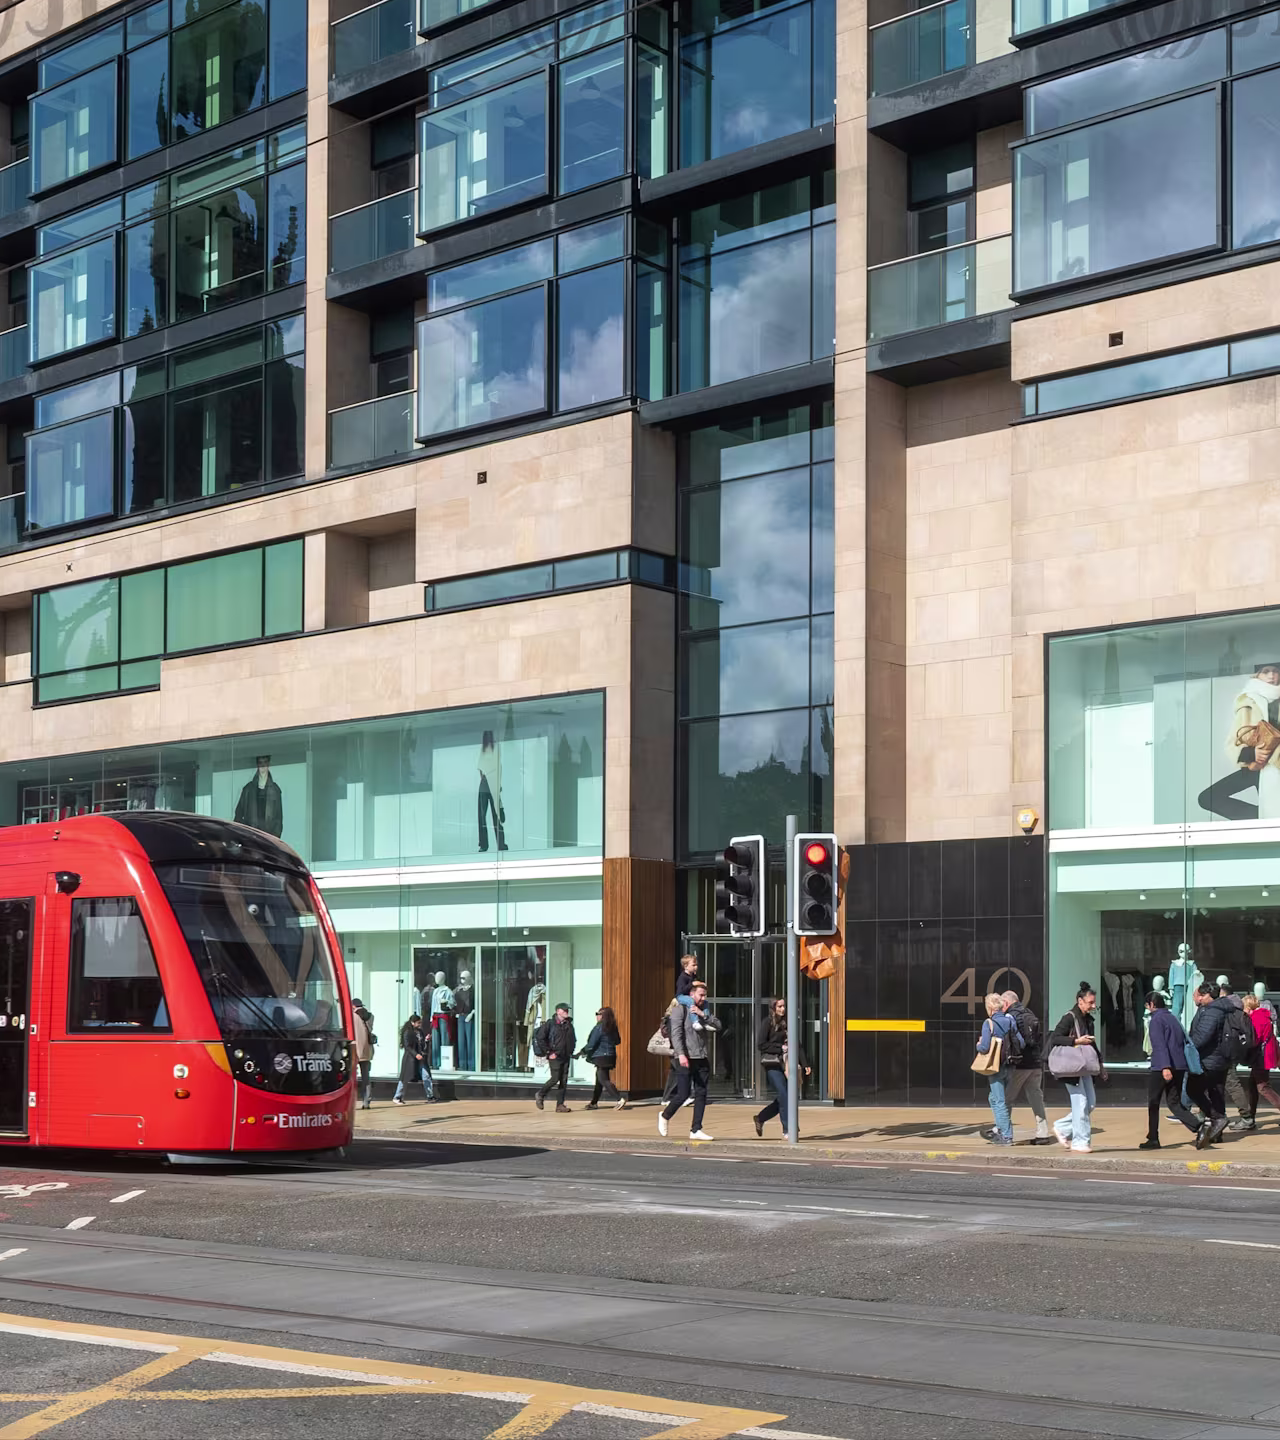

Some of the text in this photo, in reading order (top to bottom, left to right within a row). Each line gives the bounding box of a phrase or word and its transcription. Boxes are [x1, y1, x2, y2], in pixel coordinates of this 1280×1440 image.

[940, 966, 1032, 1015] 40
[293, 1055, 333, 1072] Trams
[306, 1051, 330, 1060] Edinburgh
[278, 1112, 332, 1128] Emirates
